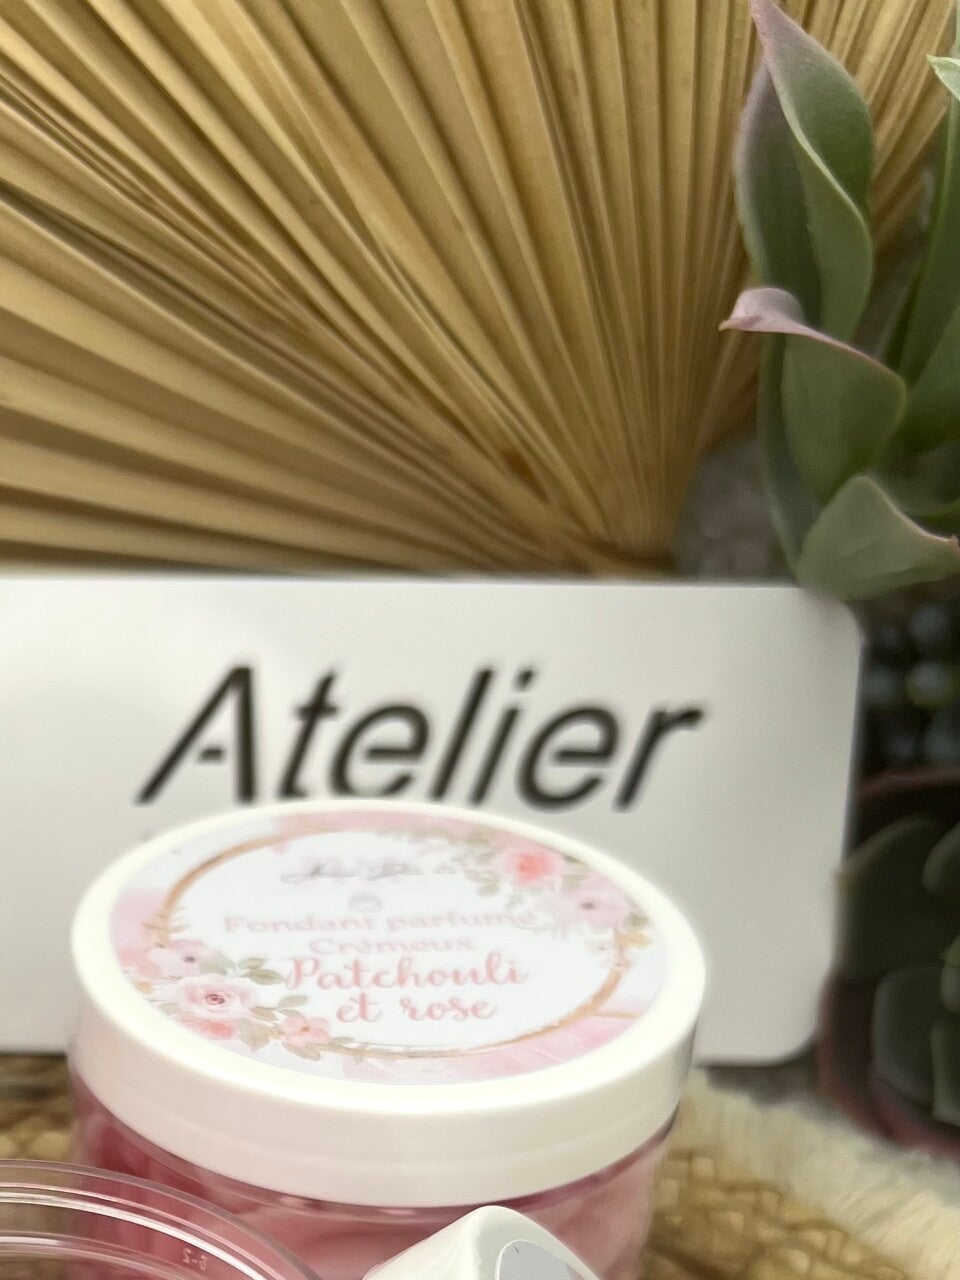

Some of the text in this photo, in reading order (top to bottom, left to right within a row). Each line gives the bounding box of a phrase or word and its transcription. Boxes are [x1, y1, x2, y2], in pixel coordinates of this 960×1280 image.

[134, 662, 706, 812] Atelier
[224, 914, 375, 933] Fondant
[285, 951, 530, 990] Patchouli
[336, 992, 497, 1023] et rose
